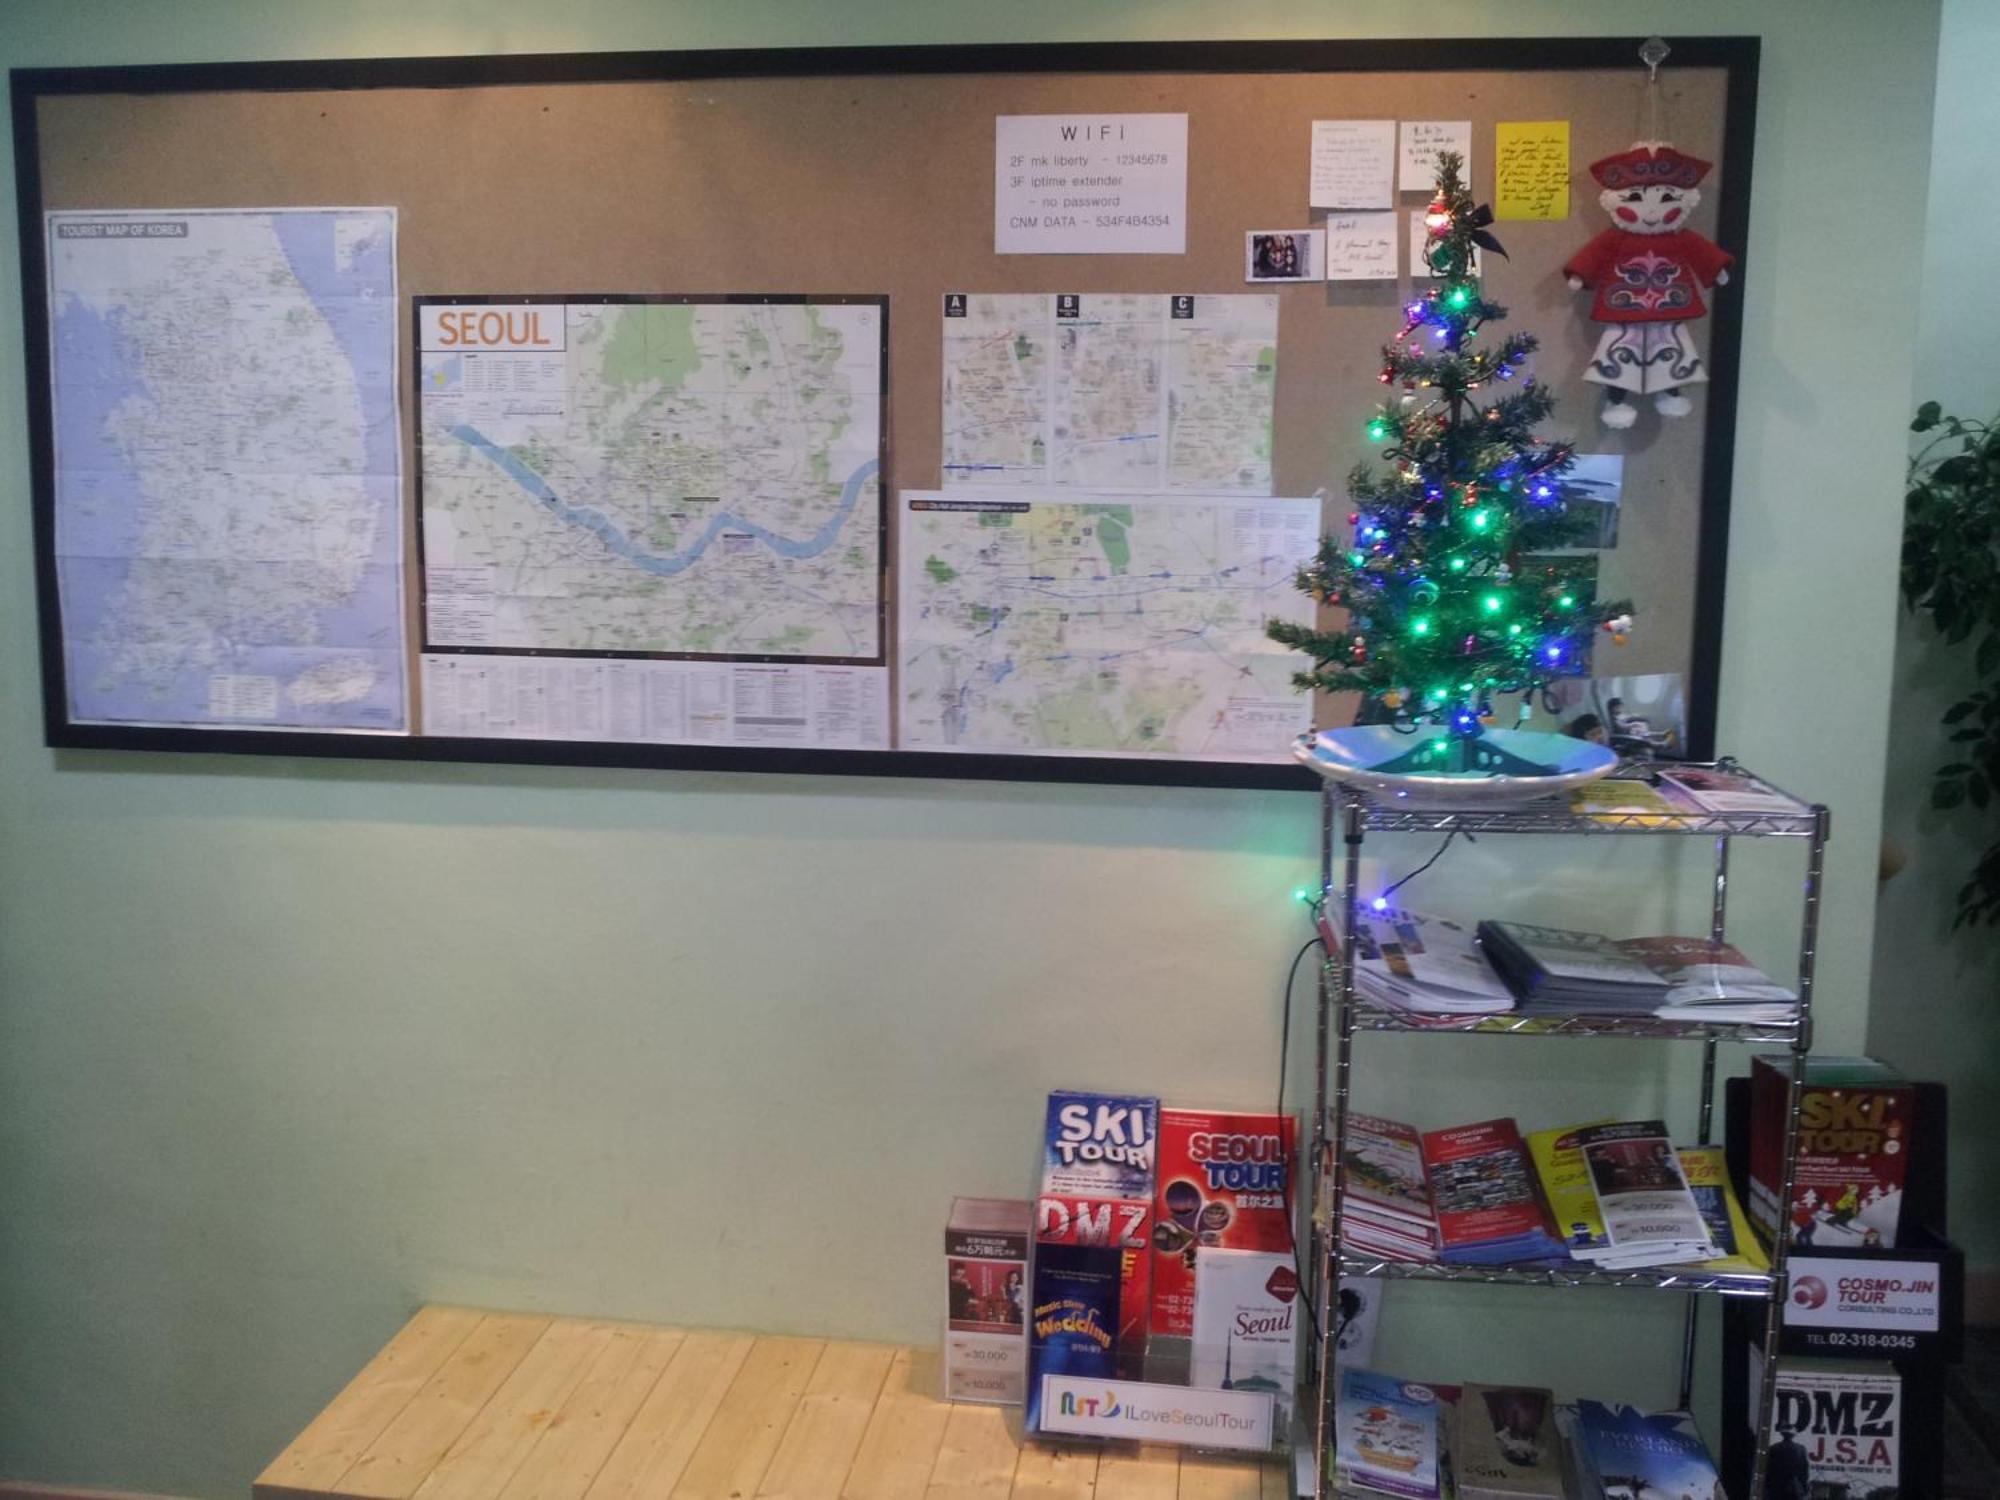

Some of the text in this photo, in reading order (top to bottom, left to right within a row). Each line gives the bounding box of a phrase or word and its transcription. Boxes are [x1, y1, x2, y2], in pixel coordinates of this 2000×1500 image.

[1010, 155, 1025, 167] 2F
[1031, 155, 1049, 167] mk
[1054, 155, 1089, 169] liberty
[1116, 153, 1169, 166] 12345678
[1010, 175, 1123, 188] 3F iptime extender
[1042, 198, 1058, 208] no
[1063, 196, 1121, 208] password
[63, 224, 184, 236] TOURIST MAP OF KOREA
[1043, 216, 1077, 228] DATA
[951, 296, 961, 308] A
[1063, 296, 1073, 308] B
[1178, 296, 1188, 309] C
[438, 311, 550, 345] SEOUL
[1799, 1092, 1885, 1129] SKI
[1060, 1104, 1145, 1146] SKI
[1188, 1132, 1287, 1164] SEOUL
[1799, 1129, 1881, 1153] TOUR
[1055, 1140, 1148, 1170] TOUR
[1201, 1162, 1285, 1190] TOUR
[1039, 1198, 1147, 1248] DMZ
[1837, 1277, 1934, 1293] COSMO.JIN
[1838, 1290, 1886, 1304] TOUR
[1034, 1308, 1112, 1349] Wedding
[1234, 1305, 1292, 1337] Seoul
[1775, 1388, 1894, 1437] DMZ
[1808, 1436, 1892, 1466] J.S.A
